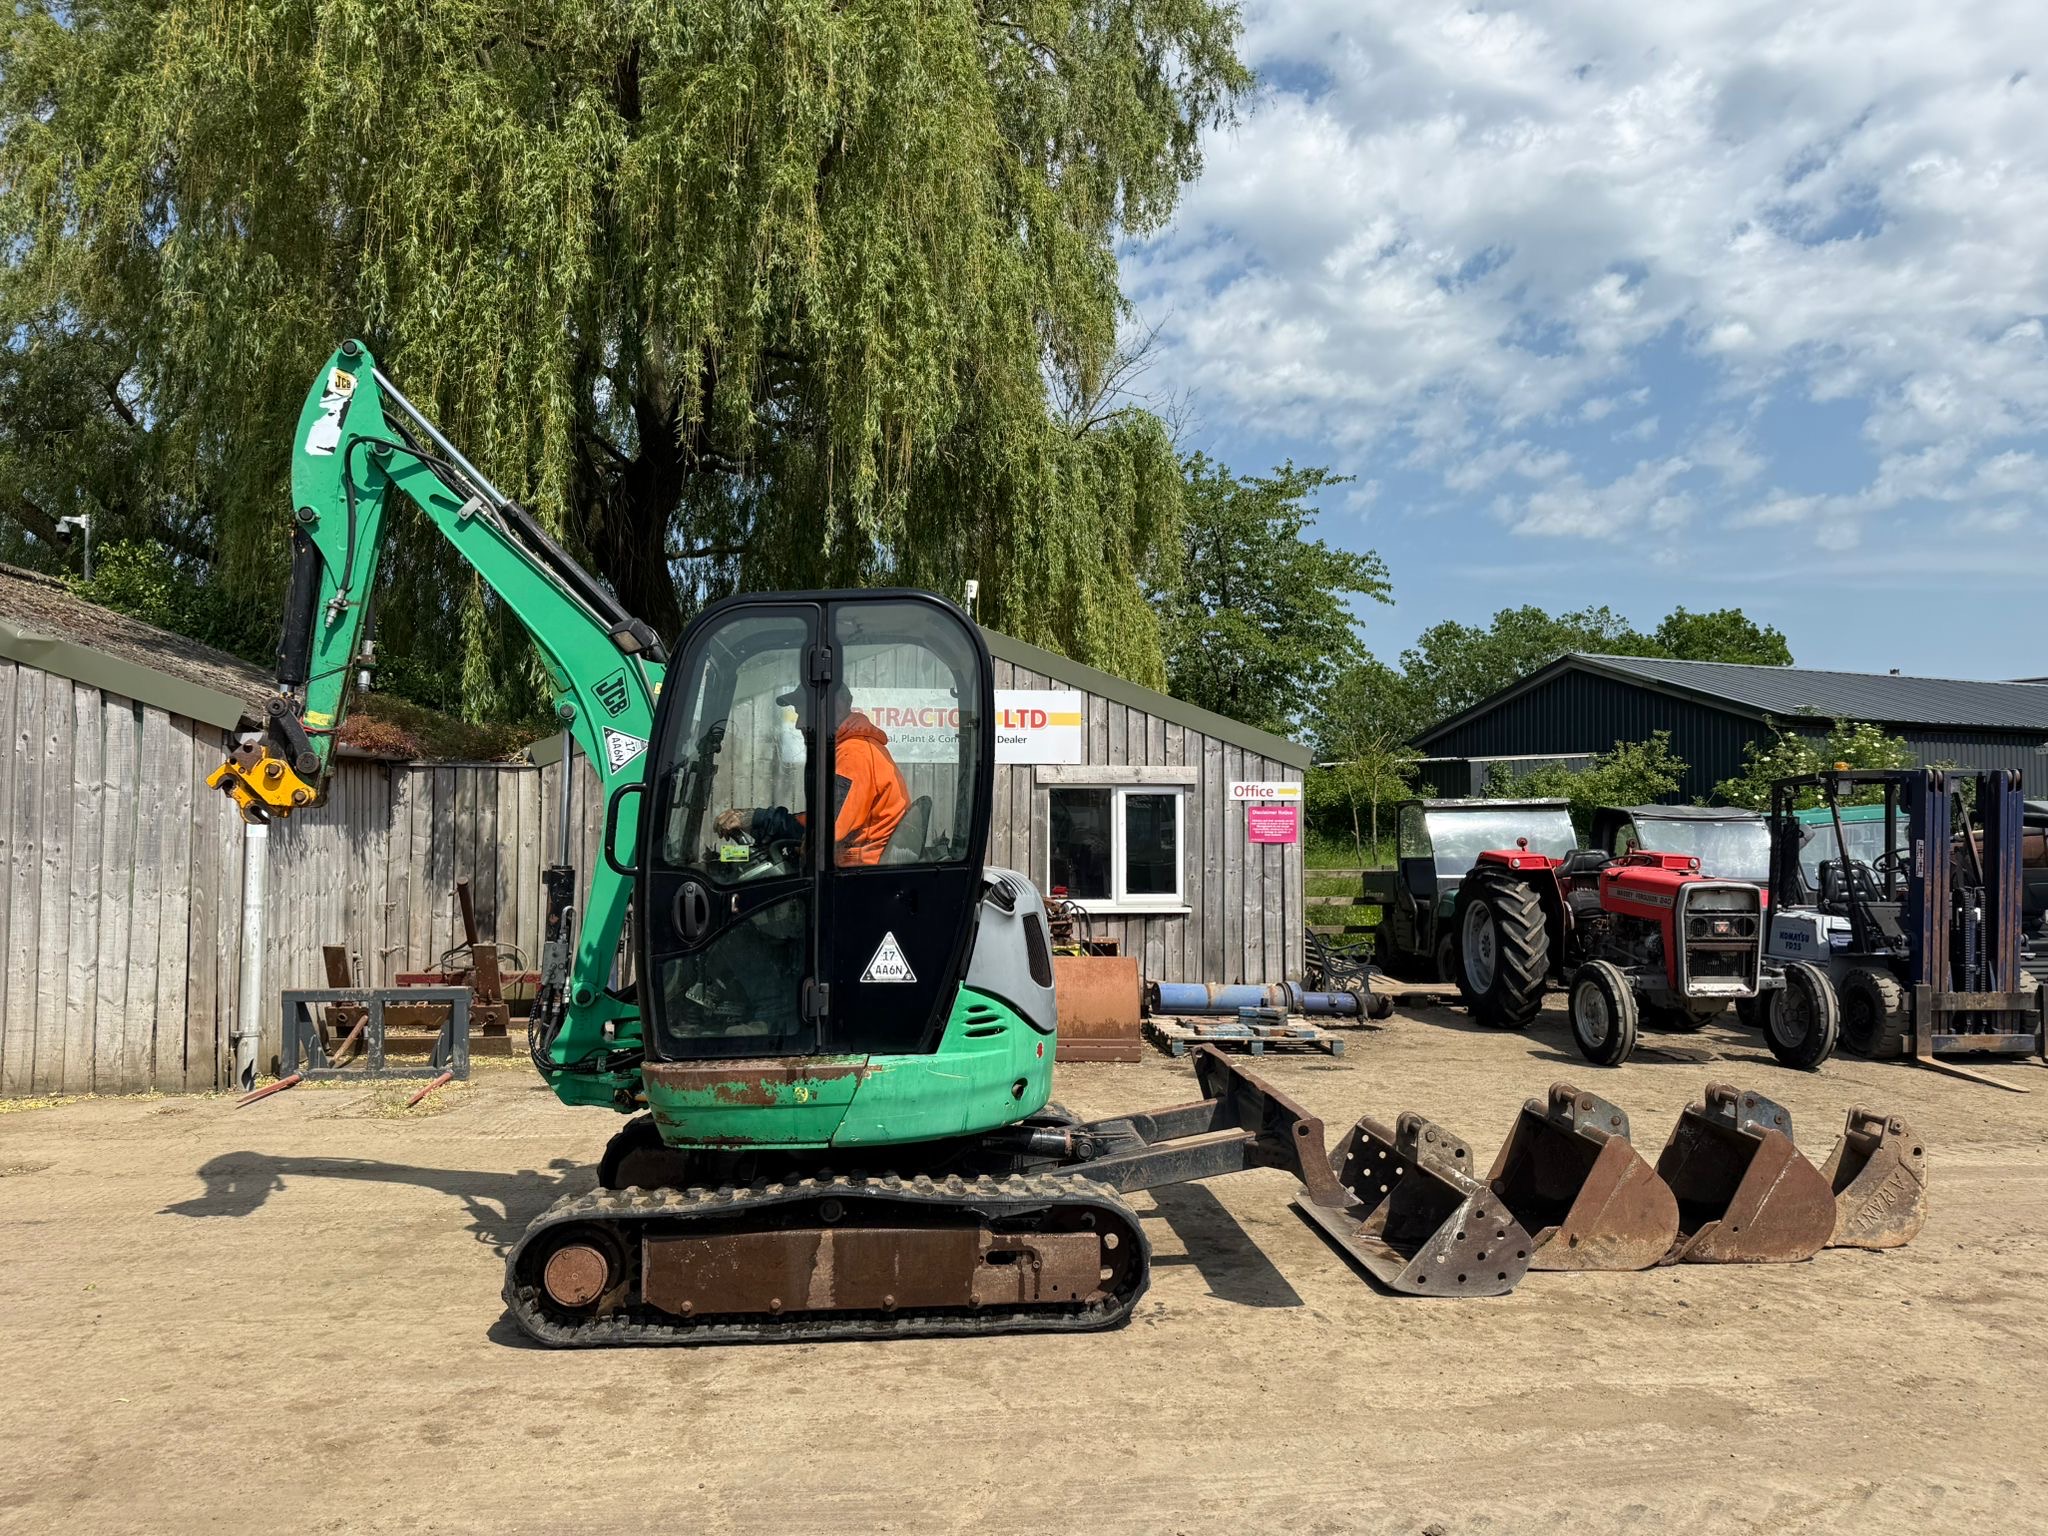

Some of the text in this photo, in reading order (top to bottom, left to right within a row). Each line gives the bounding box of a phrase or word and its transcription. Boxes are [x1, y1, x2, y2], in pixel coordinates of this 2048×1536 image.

[335, 374, 351, 389] JCB
[595, 676, 628, 715] JCB
[872, 707, 1047, 728] TRACTO LTD
[901, 734, 925, 743] Plant
[928, 735, 935, 743] &
[997, 735, 1028, 744] Dealer
[624, 740, 636, 752] 17
[1234, 785, 1274, 797] Office
[1780, 931, 1810, 942] KOMATSU
[882, 951, 896, 961] 17
[875, 964, 903, 975] AA6N
